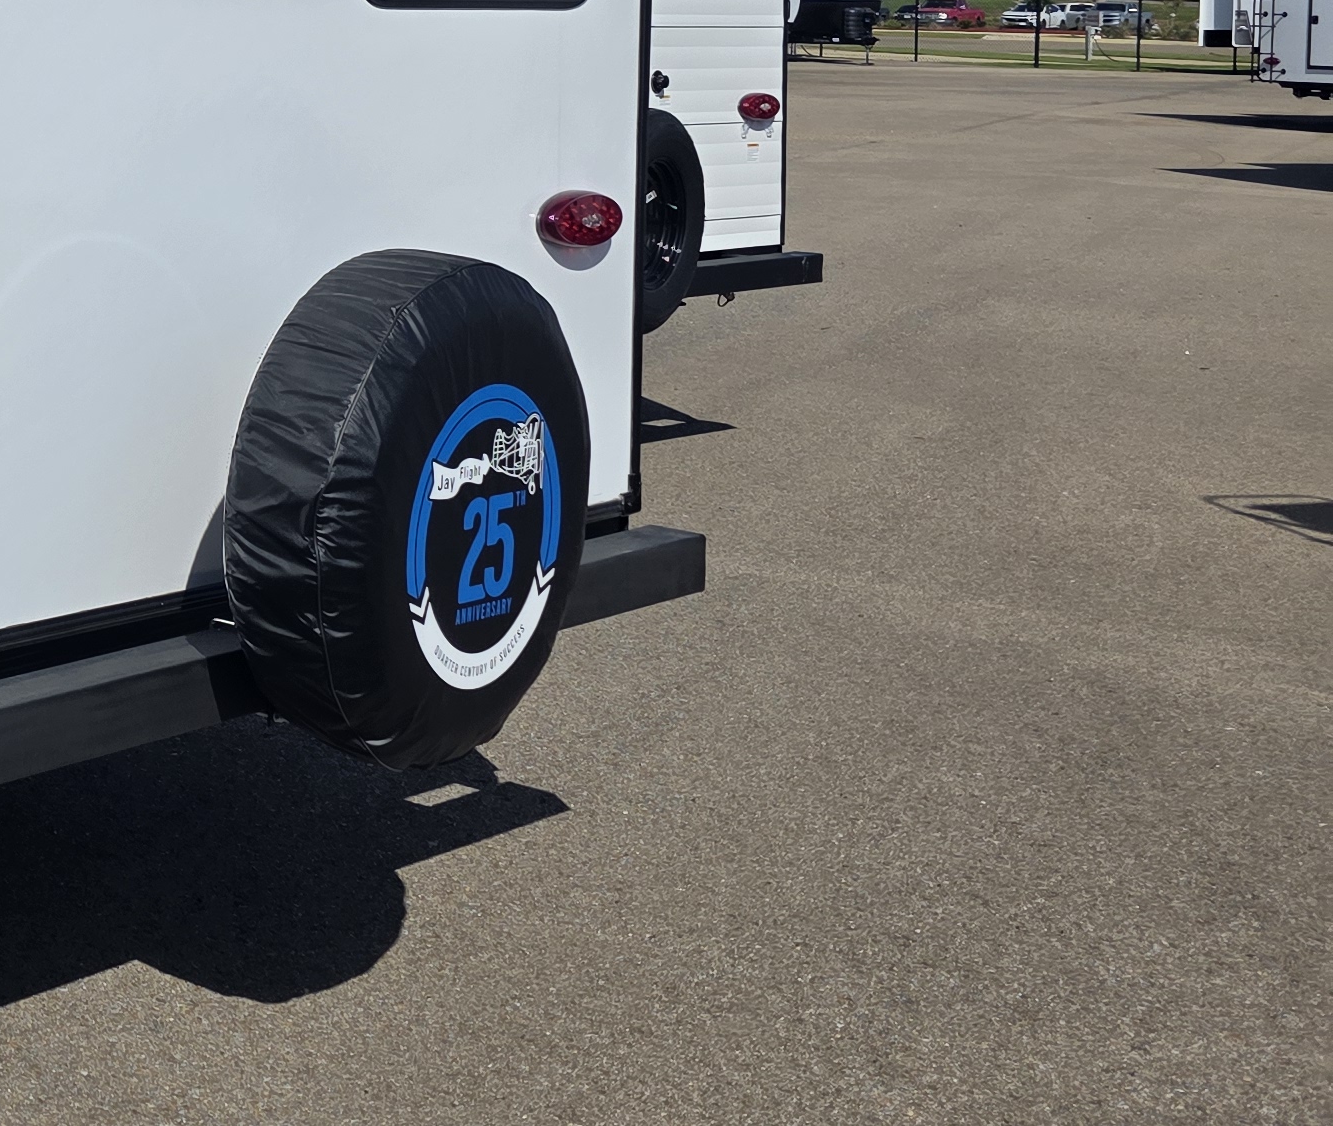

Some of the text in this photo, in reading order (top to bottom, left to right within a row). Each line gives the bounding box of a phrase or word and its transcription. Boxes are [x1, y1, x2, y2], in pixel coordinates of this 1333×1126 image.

[437, 465, 481, 492] Jay Flight
[455, 597, 512, 626] ANNIVERSARY
[434, 624, 525, 677] QUARTER CENTURY OF SUCCESS
